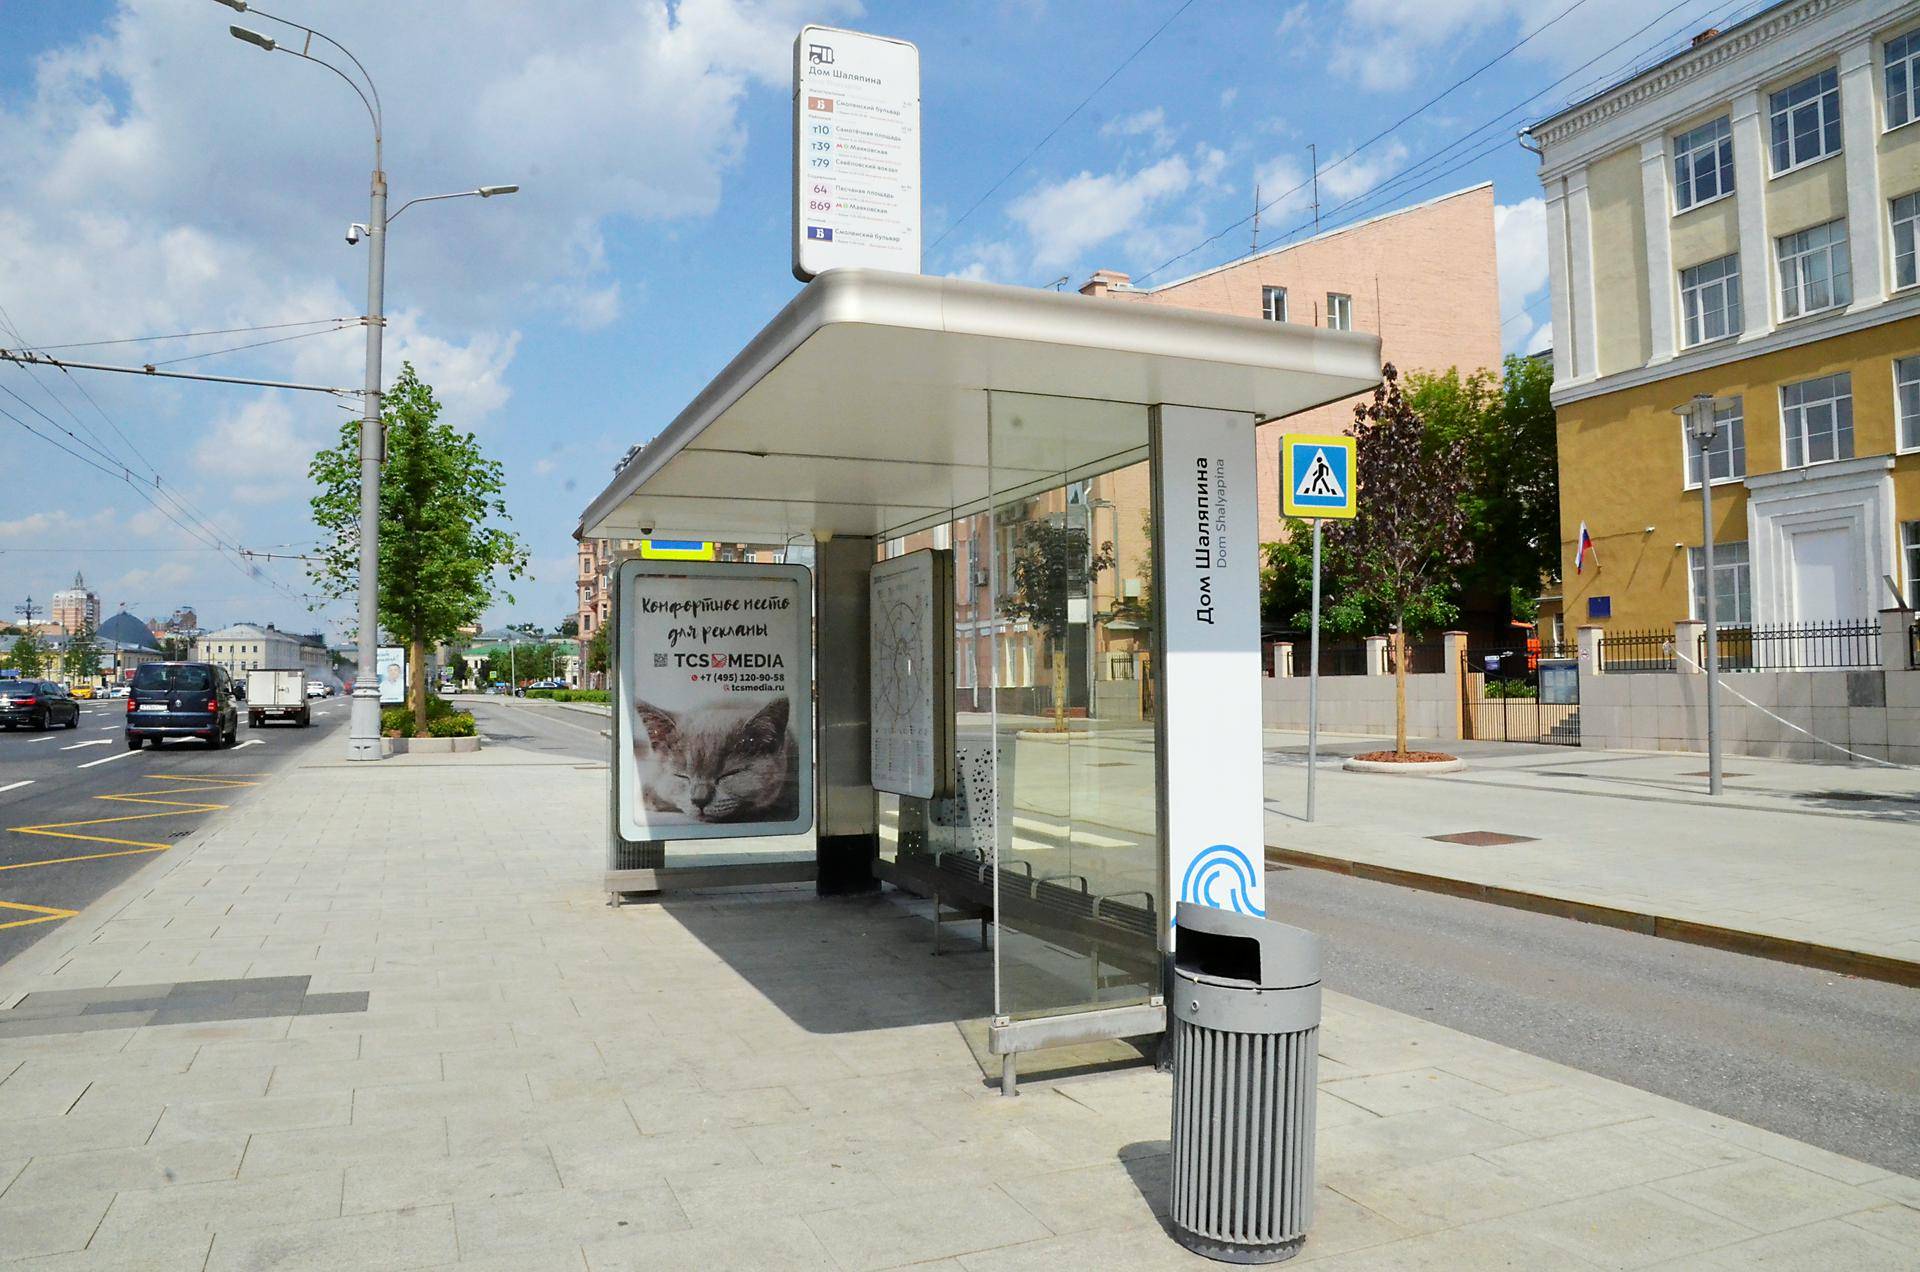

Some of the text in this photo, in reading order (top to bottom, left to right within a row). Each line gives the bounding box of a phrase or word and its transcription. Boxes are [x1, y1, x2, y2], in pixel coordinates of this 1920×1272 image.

[809, 66, 830, 77] Дом
[833, 69, 882, 85] Шаляпина
[817, 99, 825, 110] Б
[836, 99, 901, 116] Смоленский бульвар
[849, 144, 888, 155] Маяковская
[813, 184, 827, 195] 64
[810, 200, 831, 212] 869
[849, 203, 888, 214] Маяковская
[834, 228, 901, 243] Смоленский бульвар
[1215, 458, 1227, 568] Dom Shalyapina
[1195, 457, 1214, 625] Дом Шаляпина
[668, 624, 697, 648] для
[700, 672, 785, 683] +7 (495) 120-90-58
[731, 683, 785, 692] tcsmedia.ru
